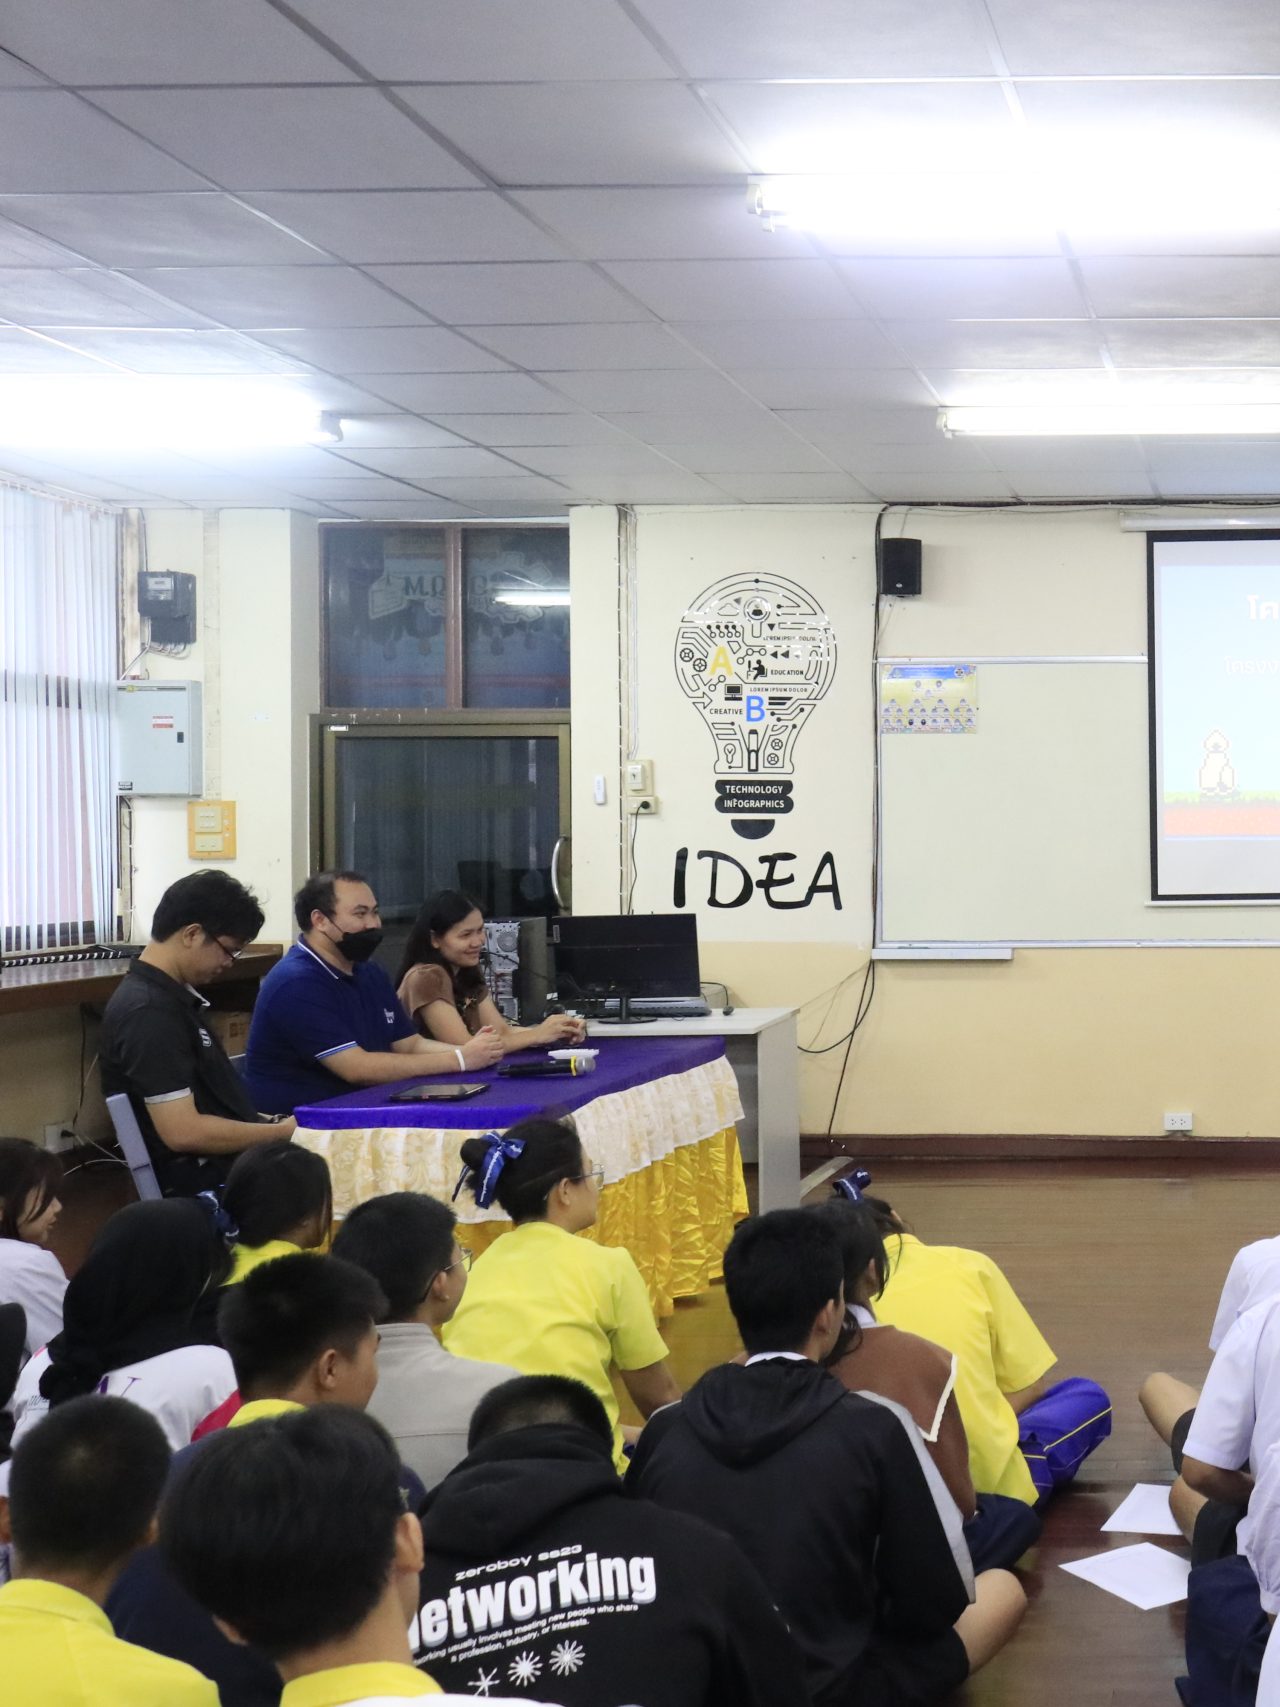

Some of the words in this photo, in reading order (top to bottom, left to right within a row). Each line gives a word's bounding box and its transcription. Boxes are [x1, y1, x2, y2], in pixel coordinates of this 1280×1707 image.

[709, 646, 733, 676] A
[746, 696, 766, 722] B
[725, 785, 783, 793] TECHNOLOGY
[724, 799, 784, 808] INFOGRAPHICS
[673, 847, 843, 910] IDEA
[455, 1555, 532, 1581] zeroboy
[447, 1638, 477, 1654] usually
[478, 1628, 513, 1644] involves
[514, 1618, 547, 1635] meeting
[548, 1612, 566, 1623] new
[567, 1607, 596, 1619] people
[597, 1605, 614, 1613] who
[615, 1603, 639, 1612] share
[459, 1642, 504, 1662] profession,
[506, 1632, 539, 1647] industry,
[541, 1626, 551, 1635] or
[552, 1618, 590, 1631] interests.
